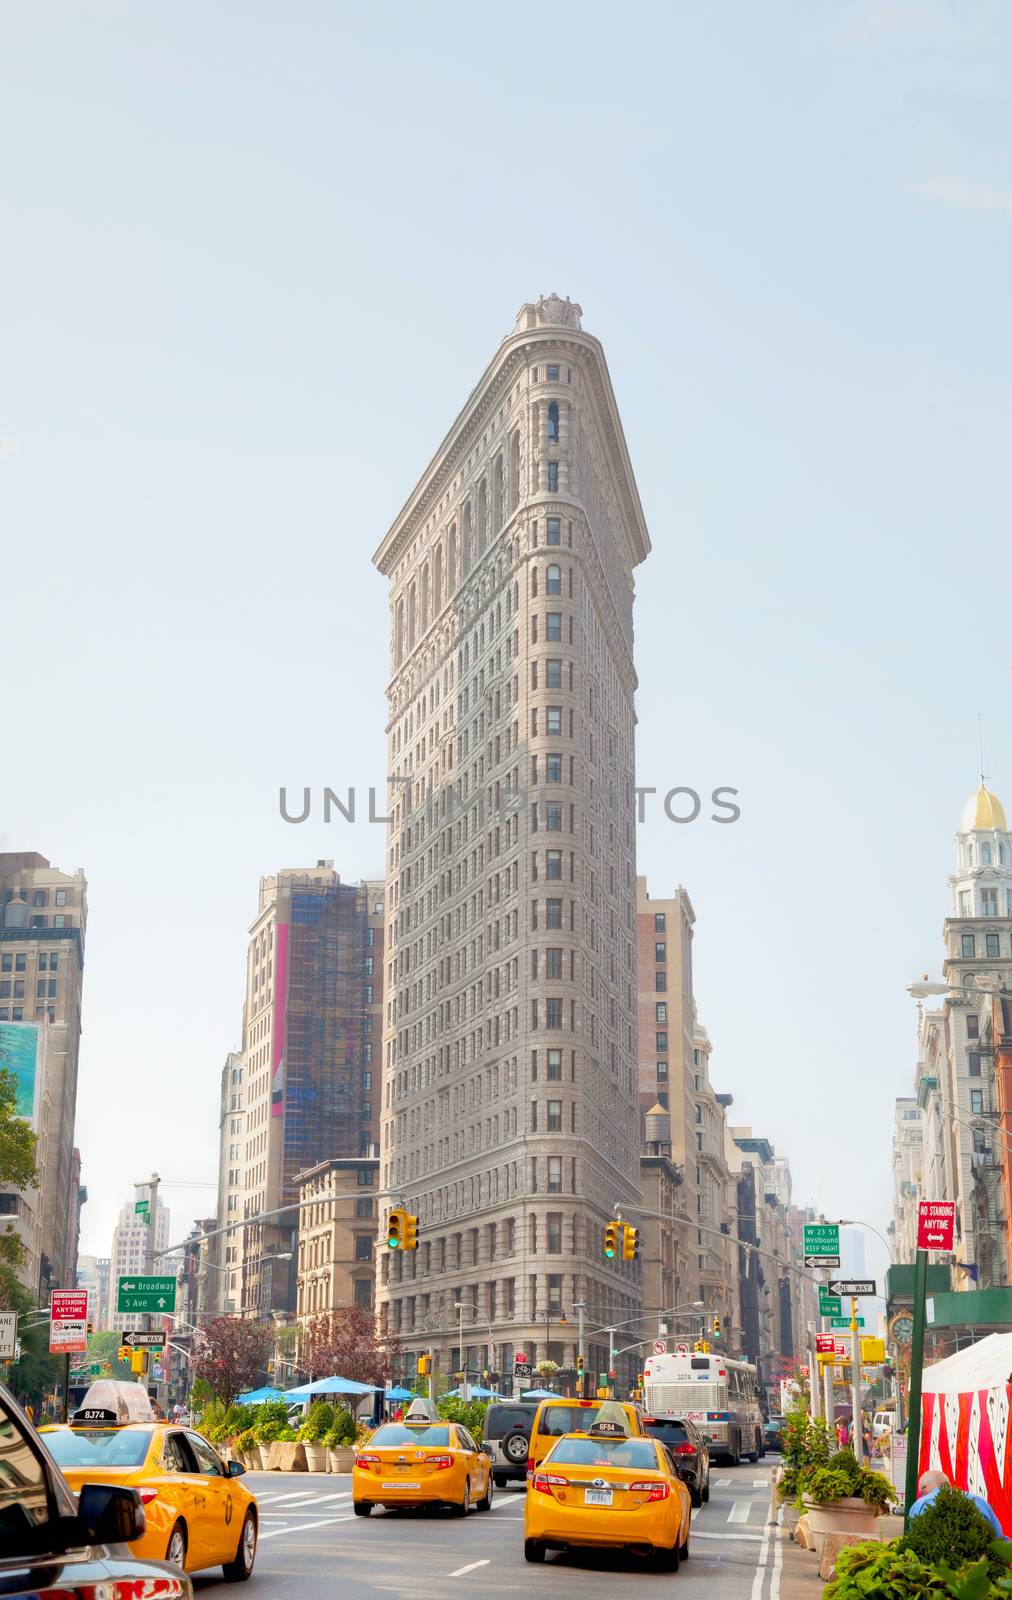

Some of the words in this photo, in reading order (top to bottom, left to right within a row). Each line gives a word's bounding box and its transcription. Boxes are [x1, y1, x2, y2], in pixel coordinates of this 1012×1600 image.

[920, 1206, 928, 1216] NO
[930, 1206, 953, 1216] STANDING
[924, 1219, 949, 1230] ANYTIME
[806, 1236, 839, 1244] Westbound
[138, 1282, 175, 1292] Broadway
[125, 1299, 130, 1307] 5
[133, 1299, 148, 1307] Ave
[84, 1410, 105, 1419] 8J74
[599, 1423, 615, 1431] 6F84
